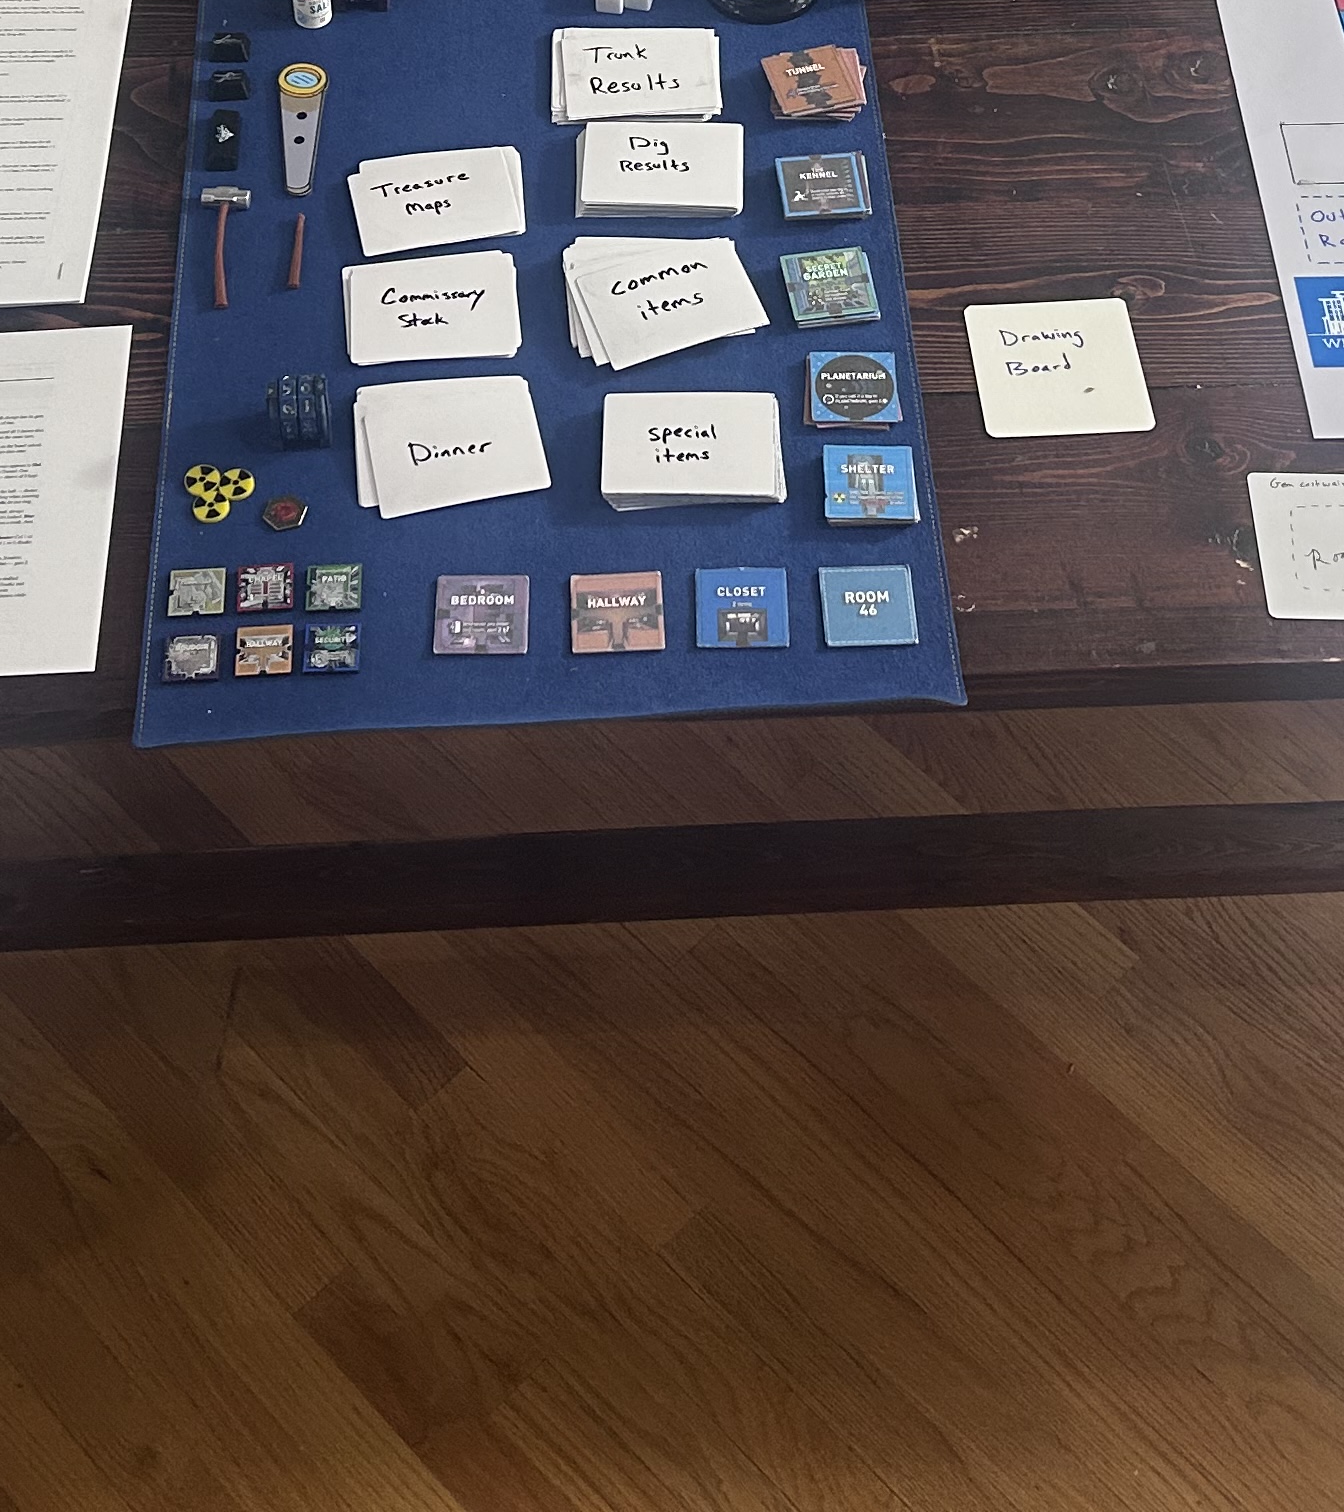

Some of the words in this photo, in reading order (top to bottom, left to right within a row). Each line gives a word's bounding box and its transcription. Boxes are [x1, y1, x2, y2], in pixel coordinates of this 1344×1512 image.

[582, 44, 648, 64] Trunk
[785, 63, 826, 76] TUNNEL
[589, 73, 681, 95] Results
[629, 136, 669, 156] Dig
[619, 158, 690, 173] Results
[799, 171, 838, 180] KENNEL
[370, 172, 470, 198] Treasure
[803, 267, 849, 281] GARDEN
[806, 262, 842, 273] SECRET
[381, 287, 486, 312] Commissary
[636, 292, 704, 321] items
[999, 329, 1084, 348] Drawing
[1005, 353, 1072, 376] Board
[821, 372, 886, 381] PLANETARIUM
[407, 441, 493, 466] Dinner
[655, 448, 710, 464] items
[841, 464, 895, 474] SHELTER
[717, 586, 766, 597] CLOSET
[844, 590, 890, 604] ROOM
[450, 595, 515, 606] BEDROOM
[587, 595, 646, 609] HALLWAY
[859, 604, 878, 616] 46
